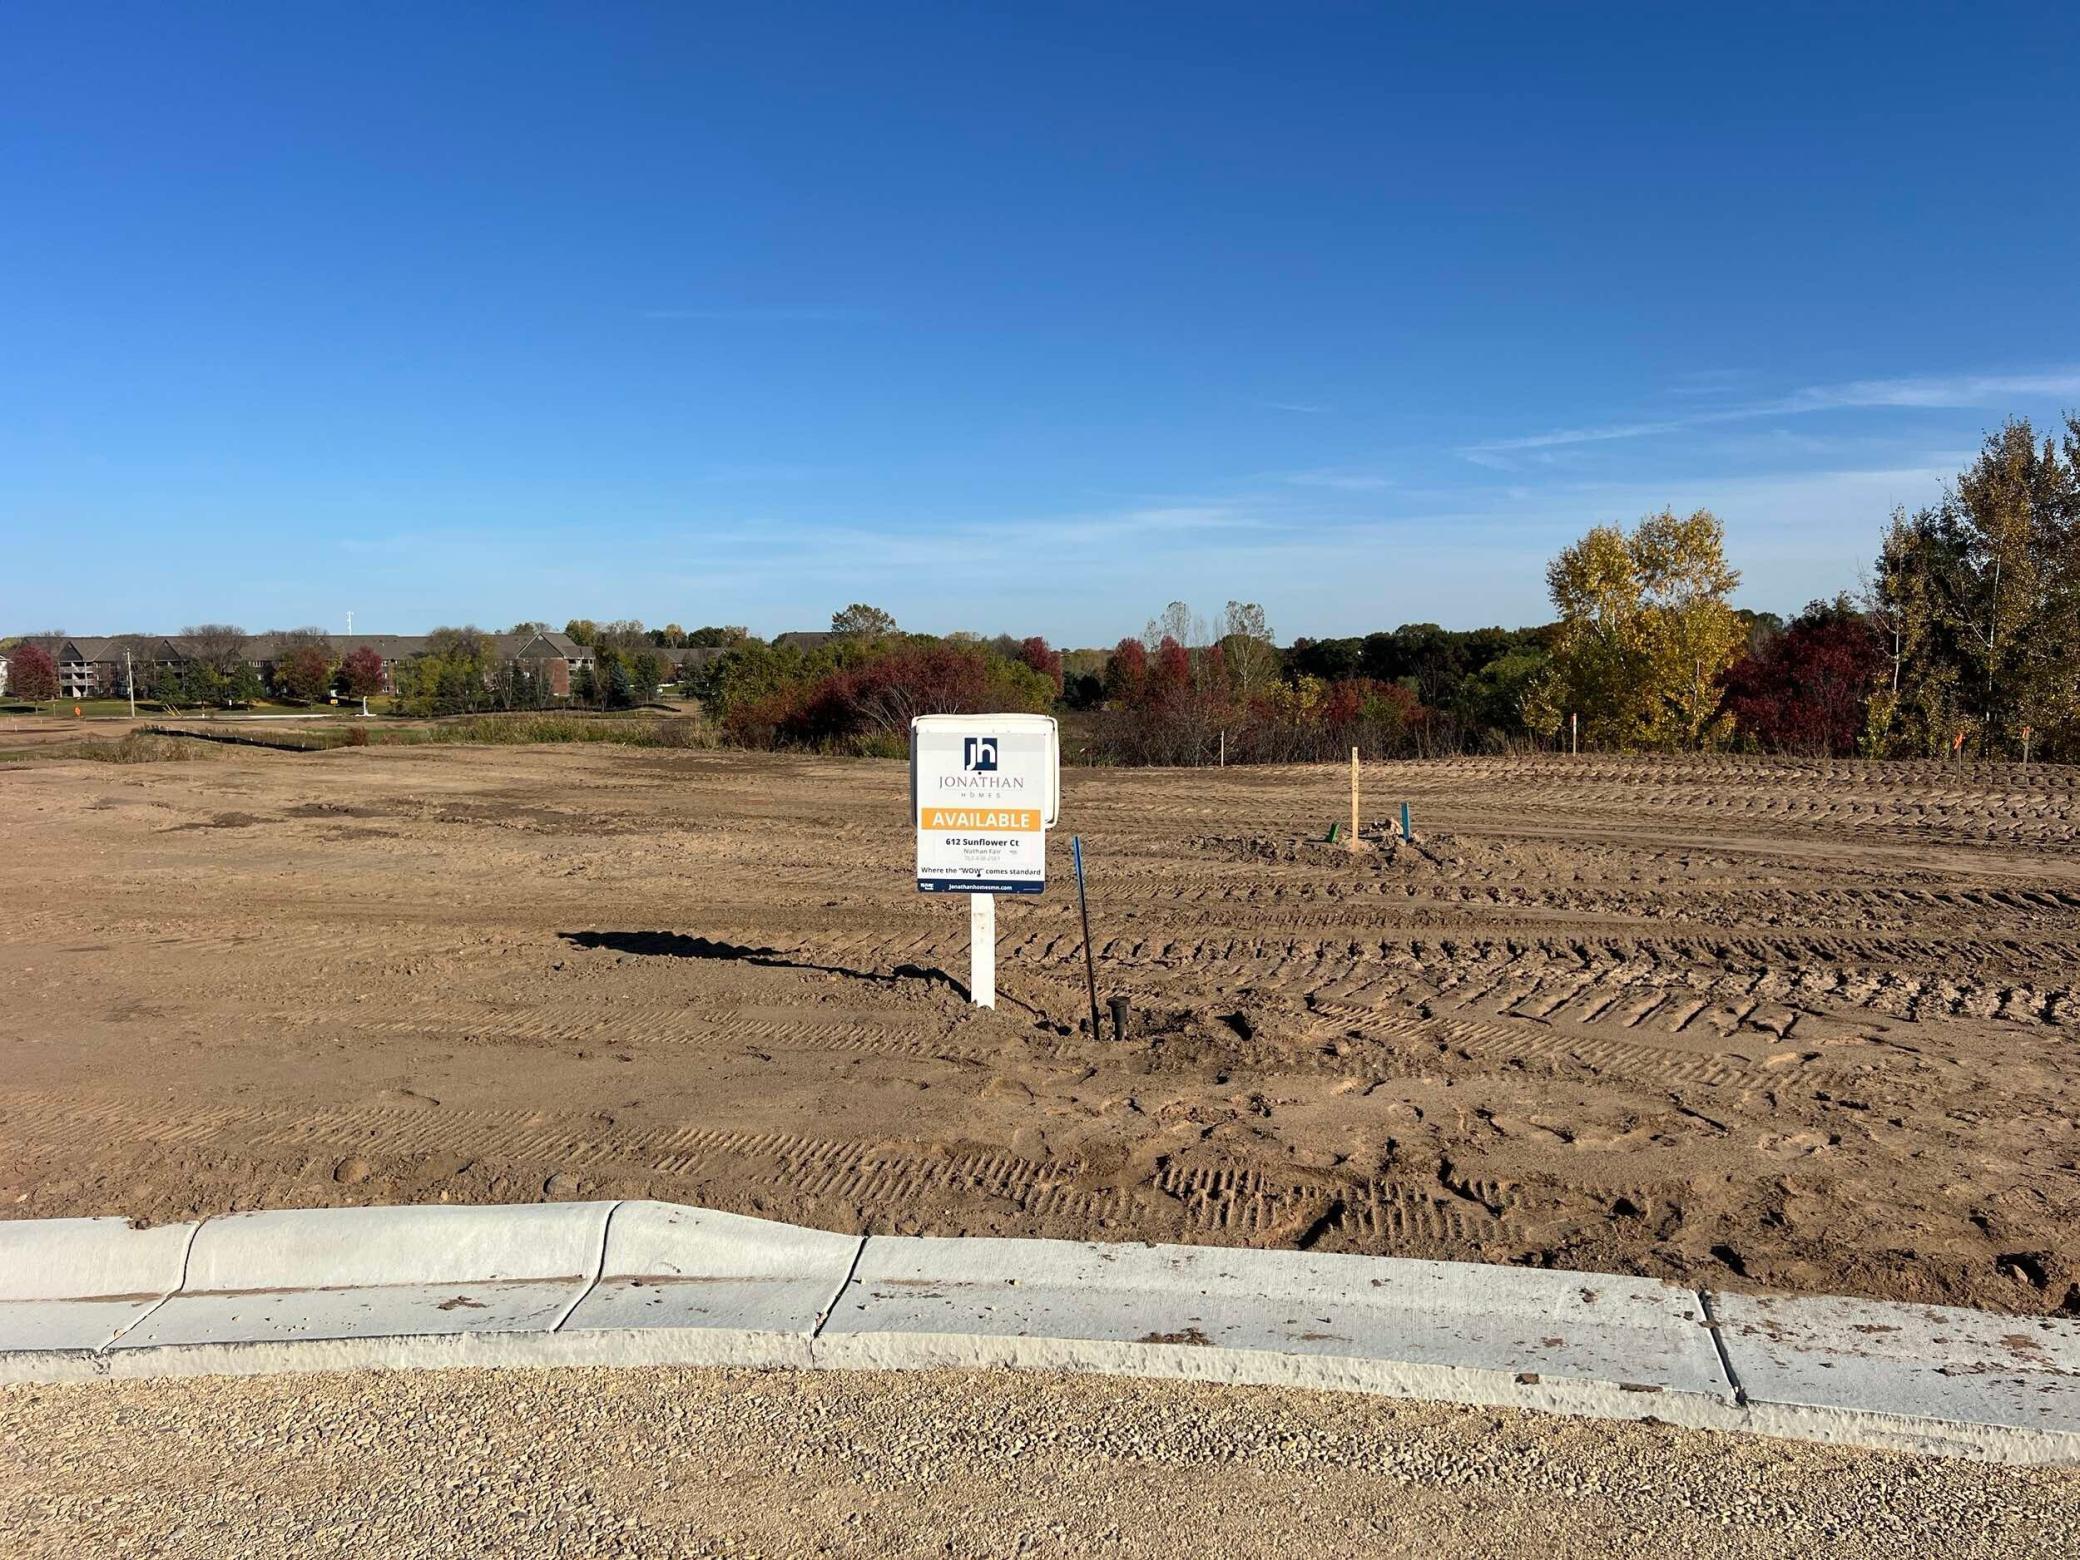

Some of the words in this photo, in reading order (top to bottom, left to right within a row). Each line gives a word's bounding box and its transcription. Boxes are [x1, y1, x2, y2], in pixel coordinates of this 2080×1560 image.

[939, 776, 1024, 788] JONATHAN
[932, 812, 1030, 828] AVAILABLE
[945, 838, 961, 846] 612
[962, 838, 1007, 847] Sunflower
[1009, 838, 1019, 847] Ct
[1009, 868, 1041, 876] standard
